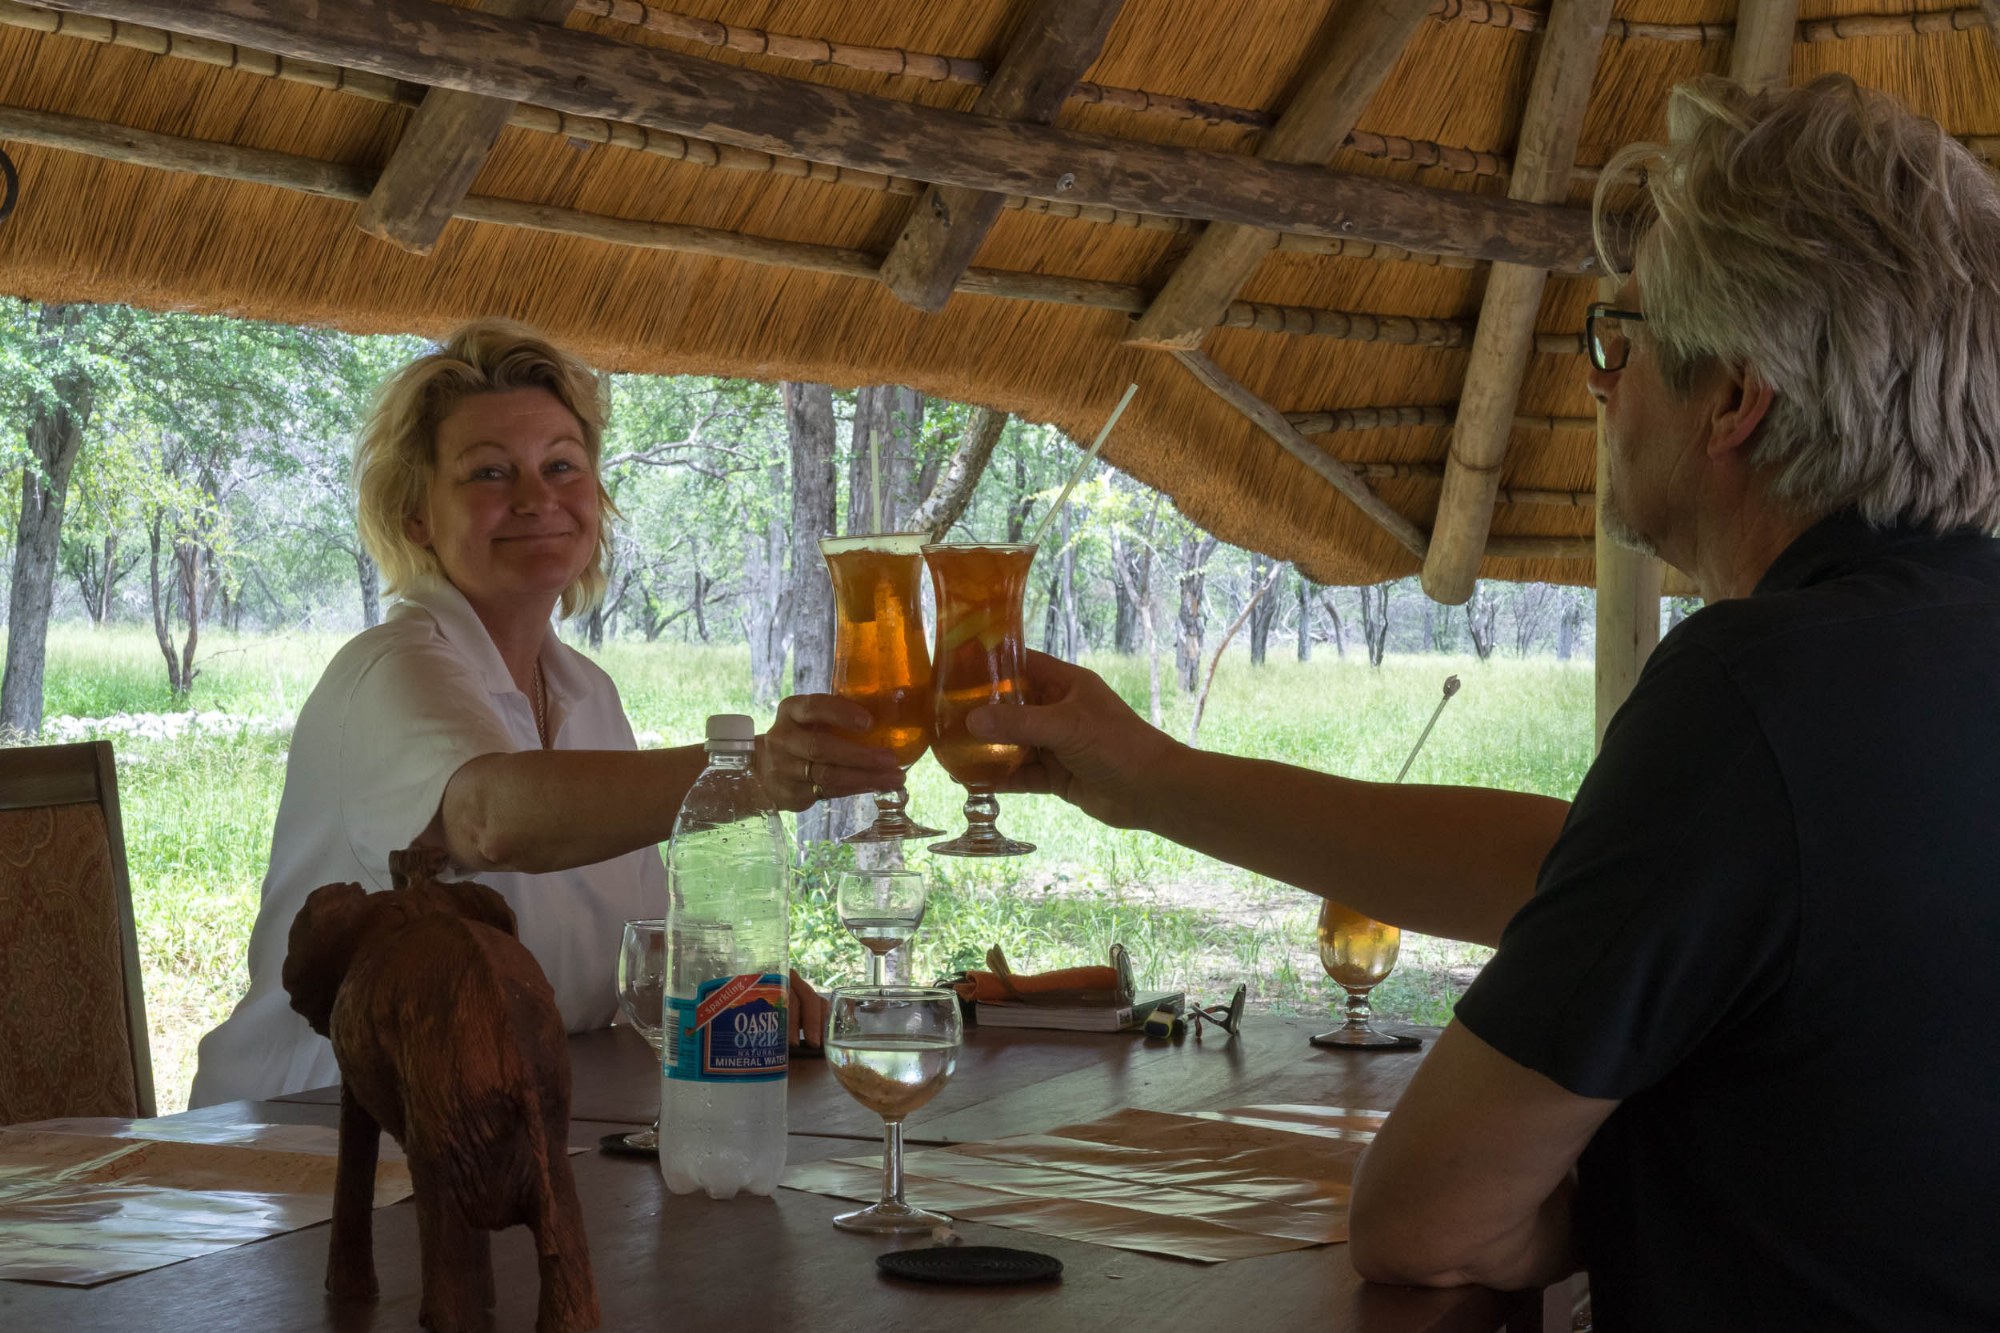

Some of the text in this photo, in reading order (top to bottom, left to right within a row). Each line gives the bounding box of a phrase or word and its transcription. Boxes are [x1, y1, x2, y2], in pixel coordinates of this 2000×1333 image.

[704, 982, 745, 1014] sparkling
[734, 1011, 779, 1034] OASIS
[715, 1057, 762, 1067] MINERAL
